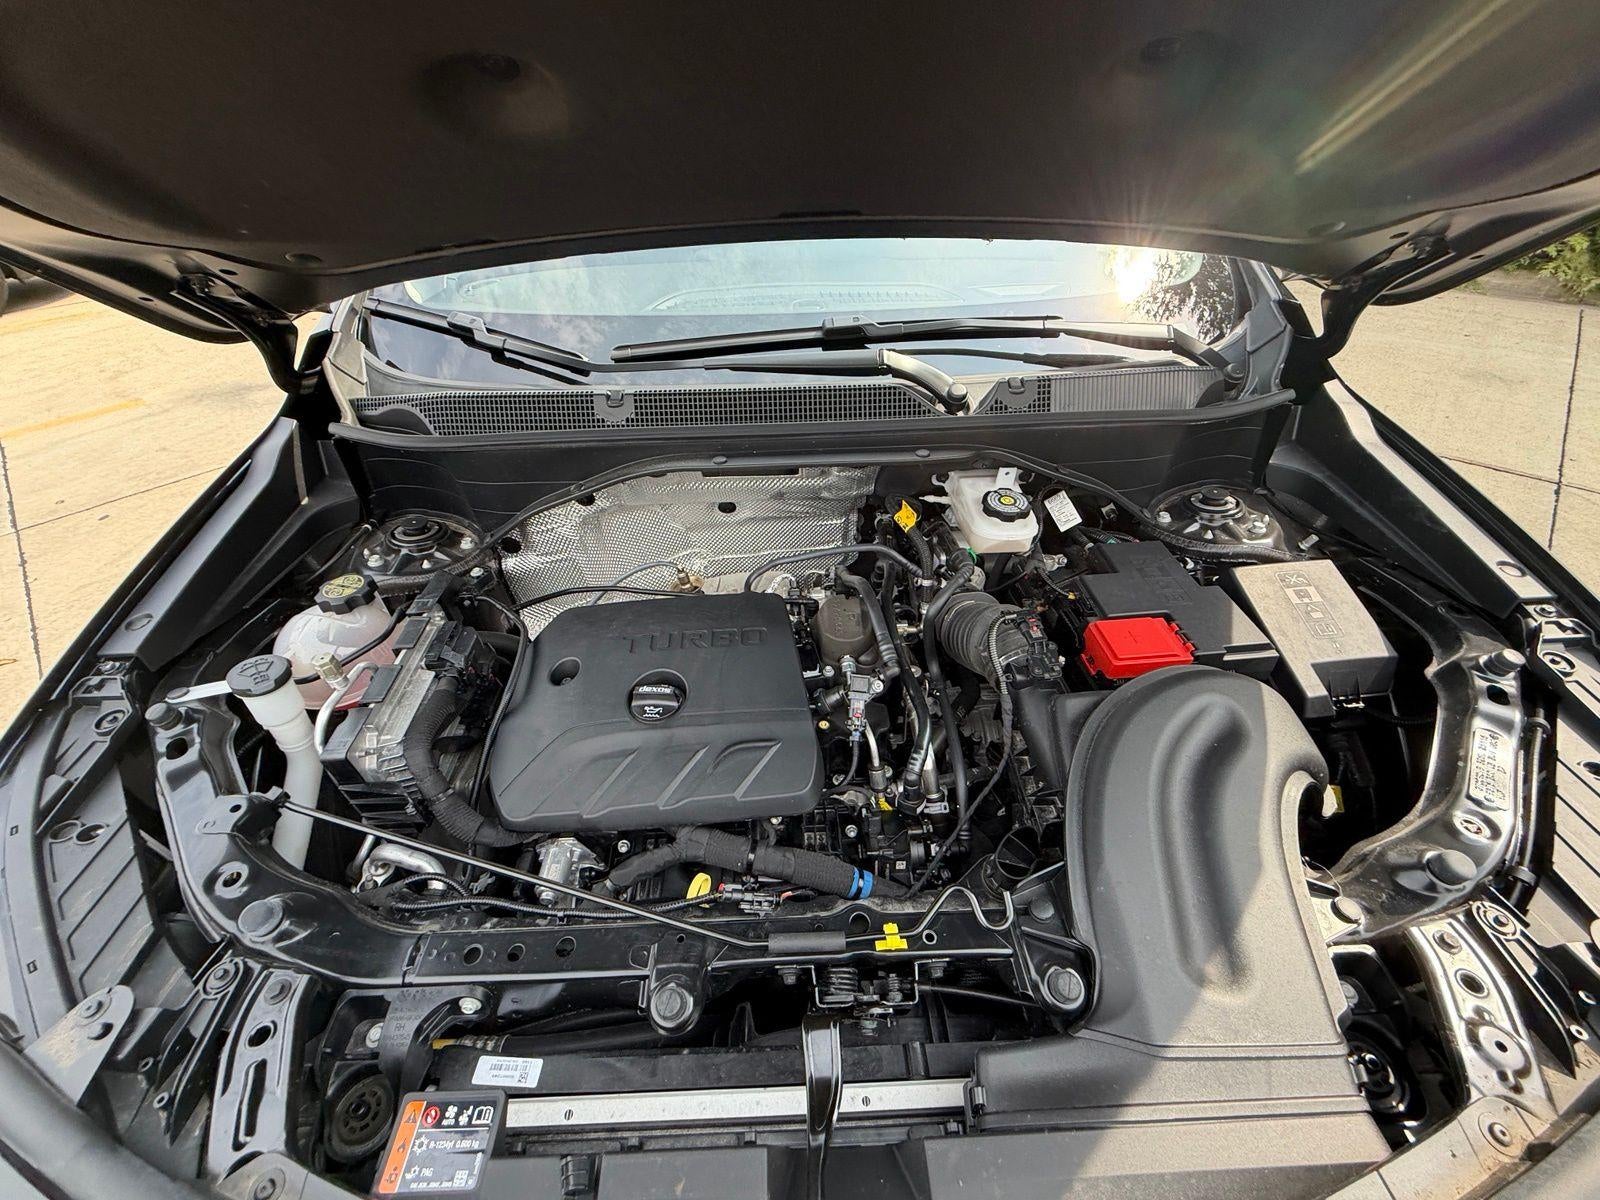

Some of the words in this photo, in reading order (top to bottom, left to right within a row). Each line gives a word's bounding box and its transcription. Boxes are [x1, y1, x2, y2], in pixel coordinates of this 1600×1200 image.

[622, 626, 768, 654] TURBO
[638, 685, 672, 694] dexos
[420, 1167, 434, 1177] PAG
